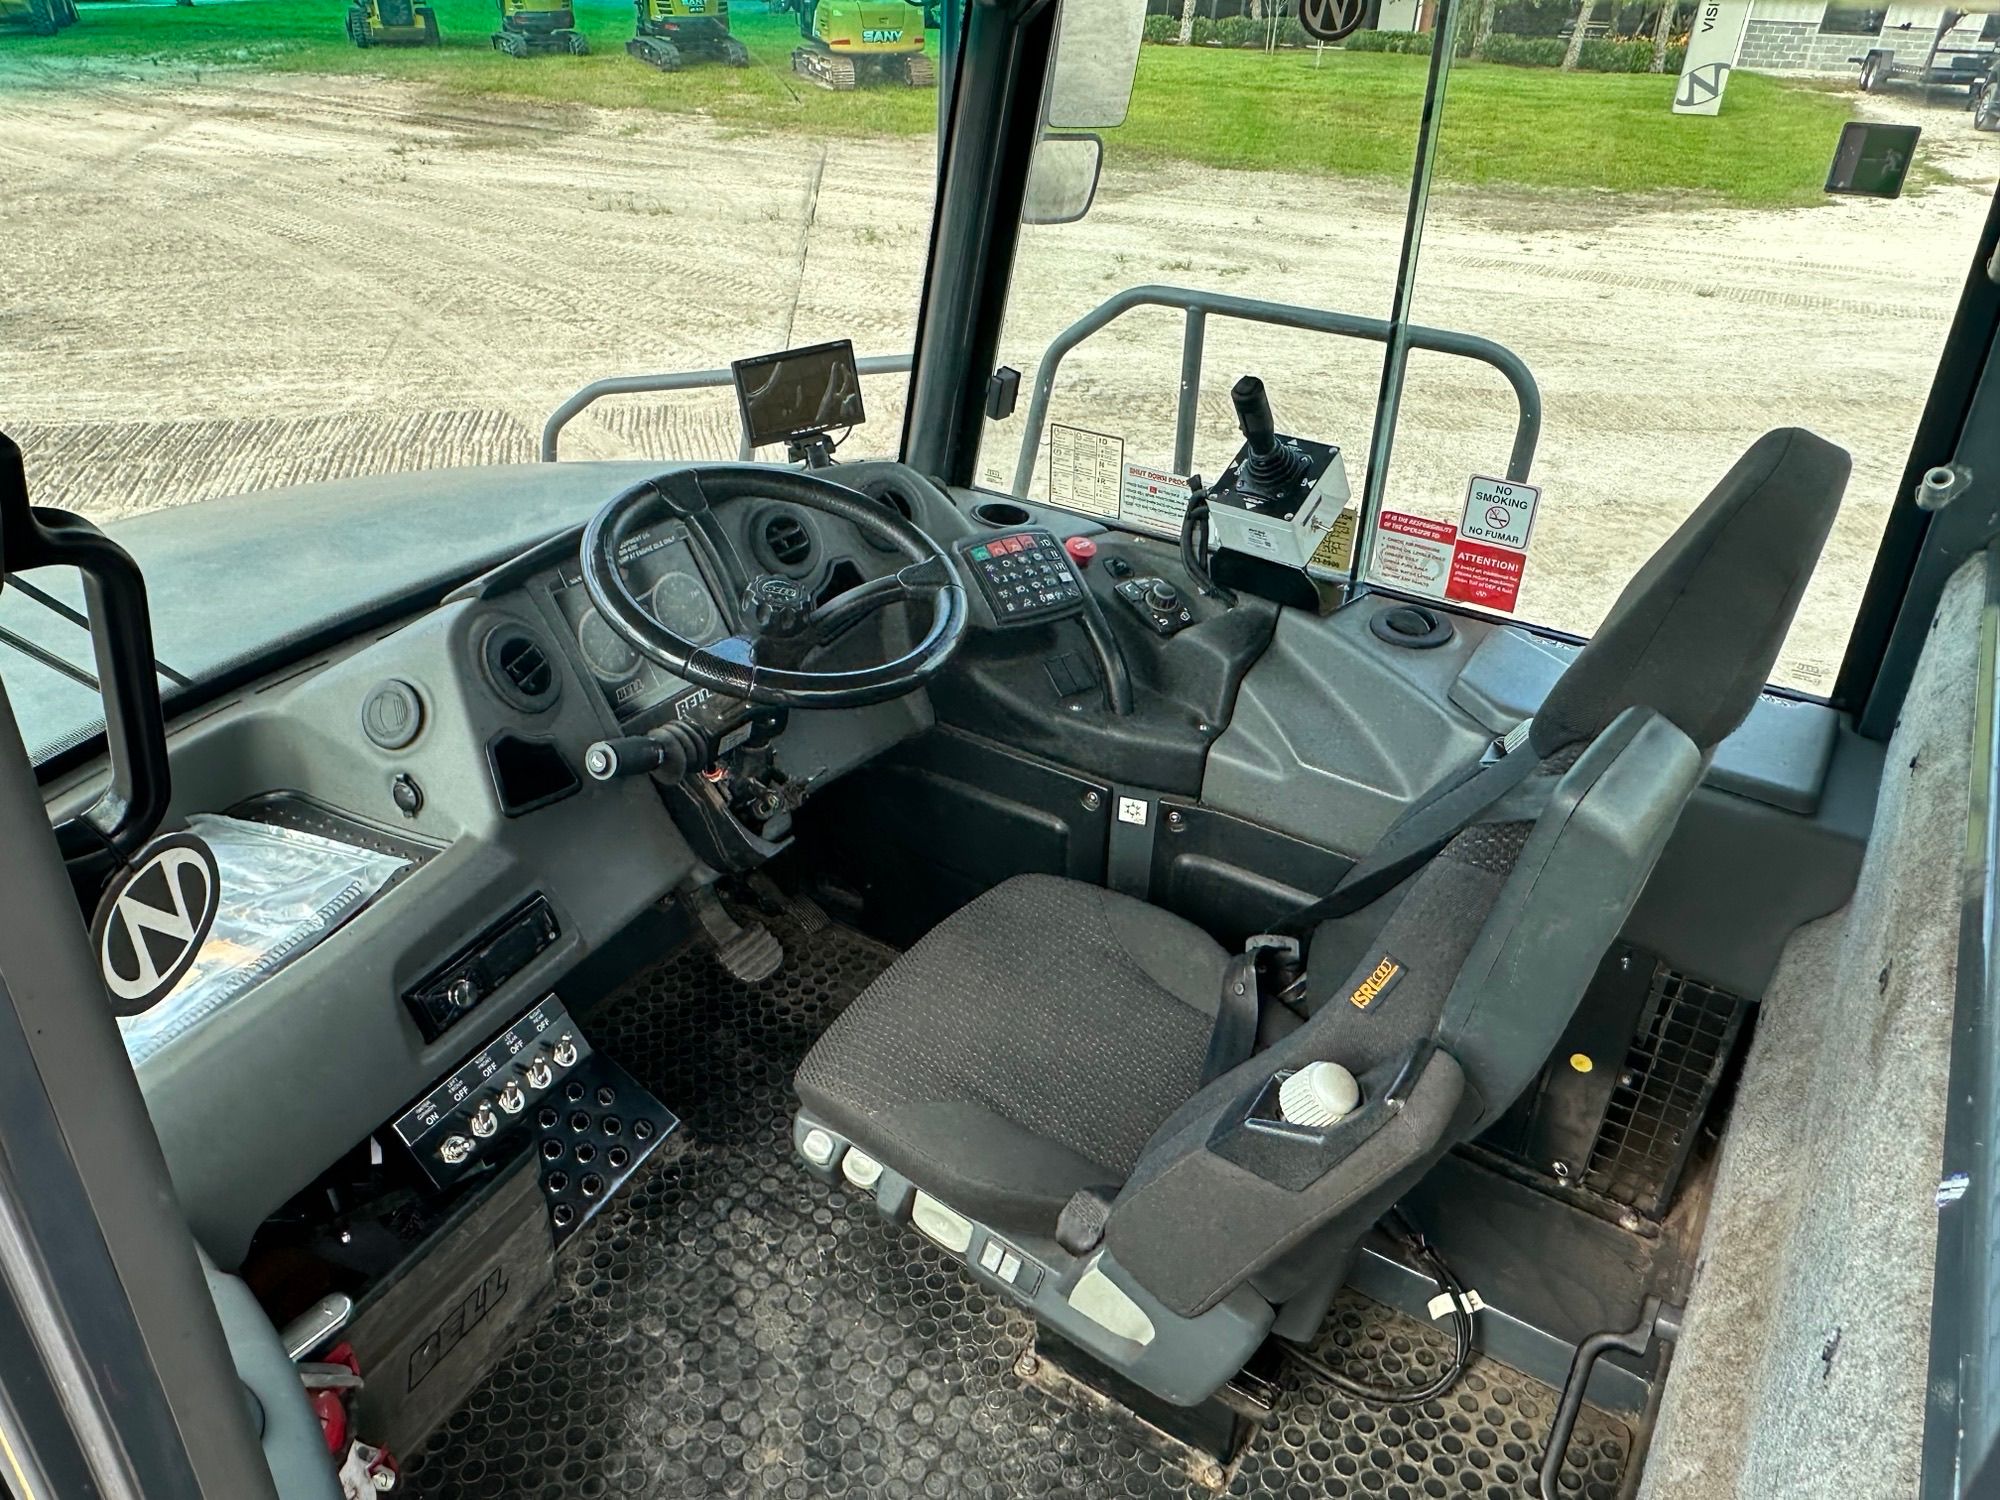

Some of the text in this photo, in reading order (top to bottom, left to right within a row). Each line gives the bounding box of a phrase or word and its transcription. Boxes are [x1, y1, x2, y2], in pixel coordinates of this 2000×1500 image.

[1701, 0, 1720, 32] VISI
[863, 30, 903, 43] SANY
[1496, 486, 1512, 496] NO
[1476, 492, 1528, 510] SMOKING
[1468, 526, 1519, 544] NO FUMAR
[1458, 552, 1518, 572] ATTENTION!
[536, 1018, 550, 1032] OFF
[510, 1040, 524, 1054] OFF
[482, 1062, 497, 1077] OFF
[454, 1086, 468, 1102] OFF
[426, 1112, 440, 1126] ON
